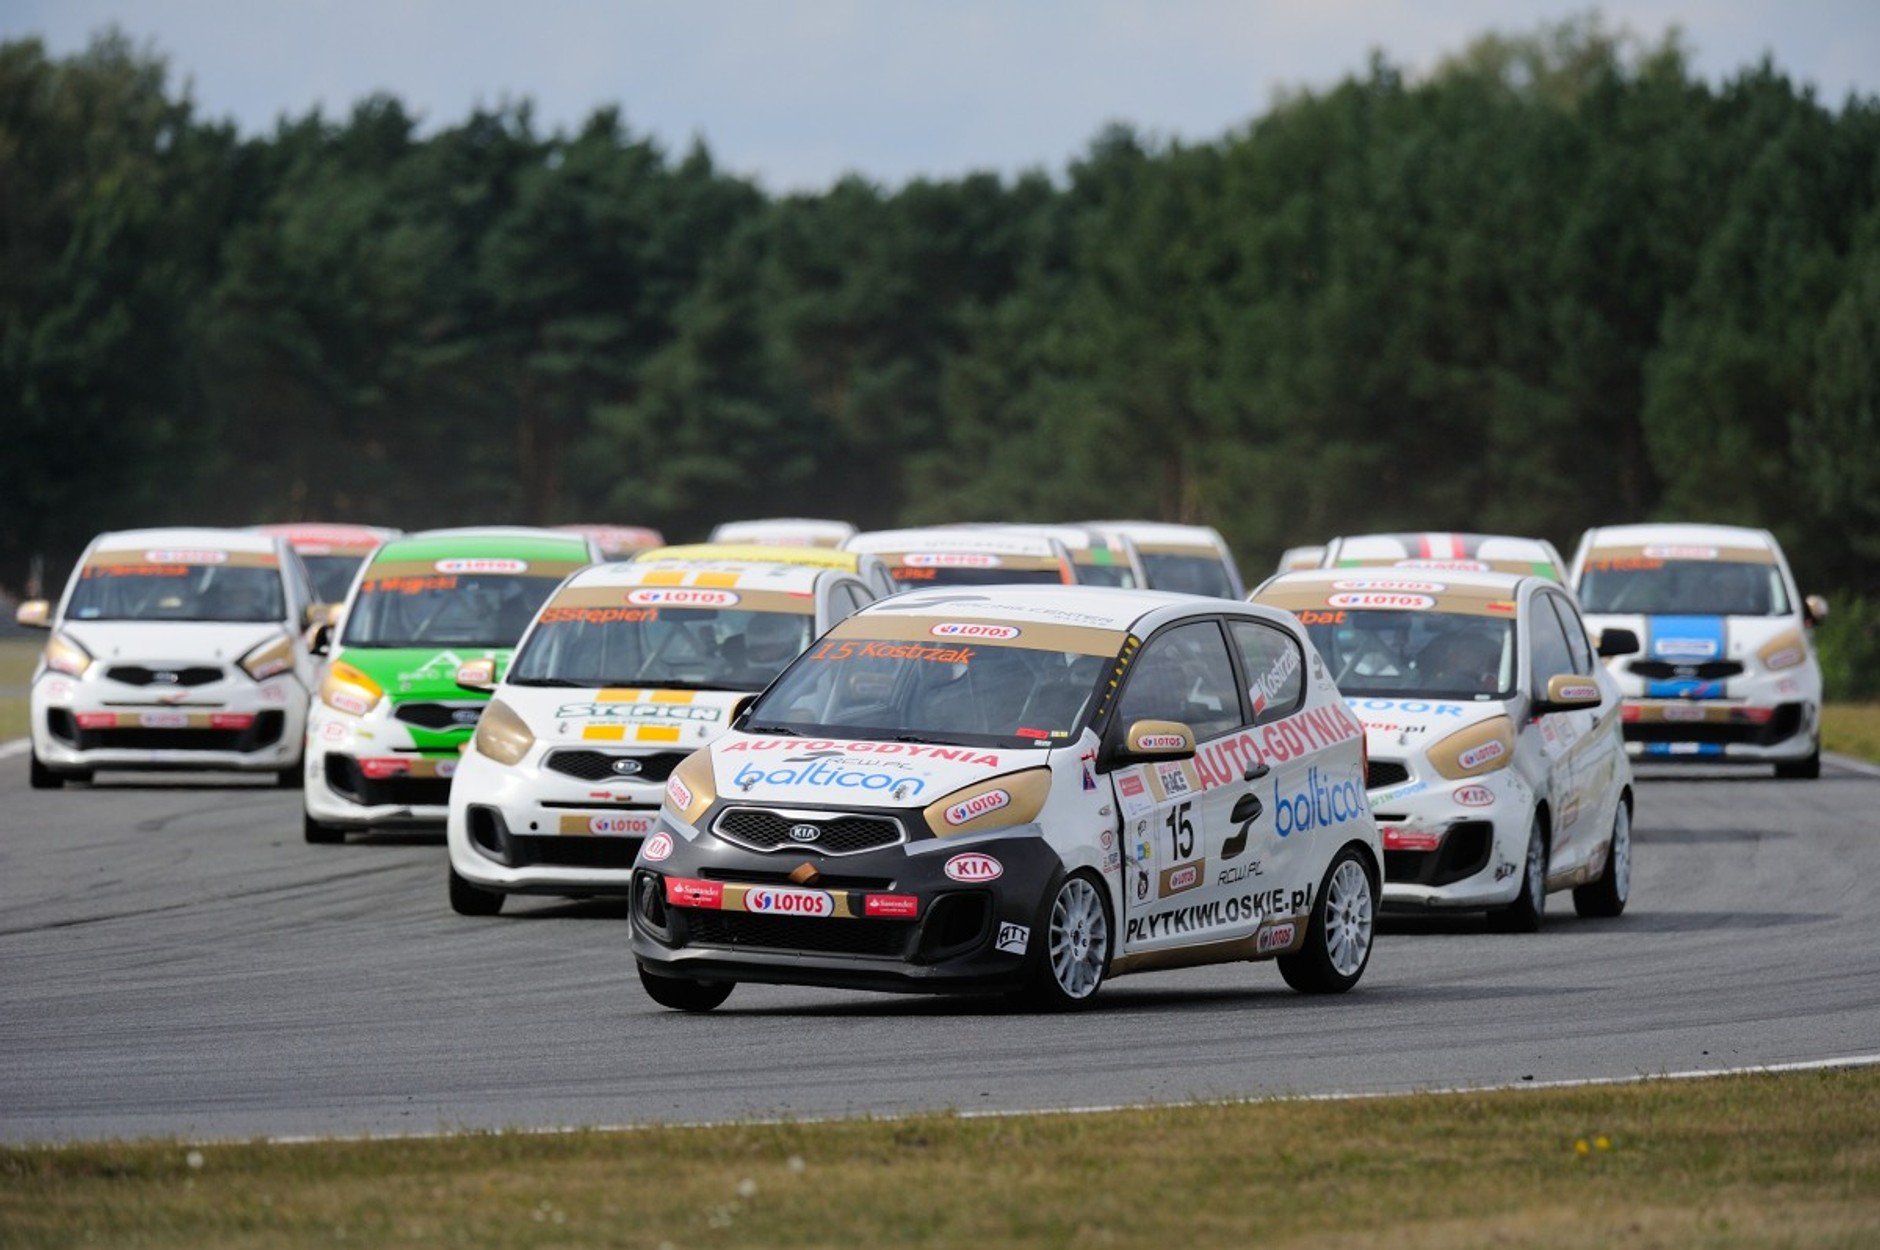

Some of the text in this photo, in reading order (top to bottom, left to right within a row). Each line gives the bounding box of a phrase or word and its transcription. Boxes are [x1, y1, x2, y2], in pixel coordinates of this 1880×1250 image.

[664, 592, 727, 603] LOTOS
[1364, 595, 1422, 606] LOTOS
[960, 625, 1011, 637] LOTOS
[810, 641, 976, 664] 15 Kostrzak
[1154, 736, 1181, 747] LOTOS
[1193, 704, 1360, 792] AUTO-GDYNIA
[721, 740, 999, 768] AUTO-GDYNIA
[733, 762, 926, 796] balticon
[966, 792, 1003, 814] LOTOS
[611, 819, 648, 832] LOTOS
[794, 827, 817, 839] KIA
[1166, 800, 1194, 861] 15
[650, 839, 667, 856] KIA
[957, 861, 993, 876] KIA
[774, 894, 824, 913] LOTOS
[1126, 883, 1312, 943] PLYTKIWLOSKIE.pl
